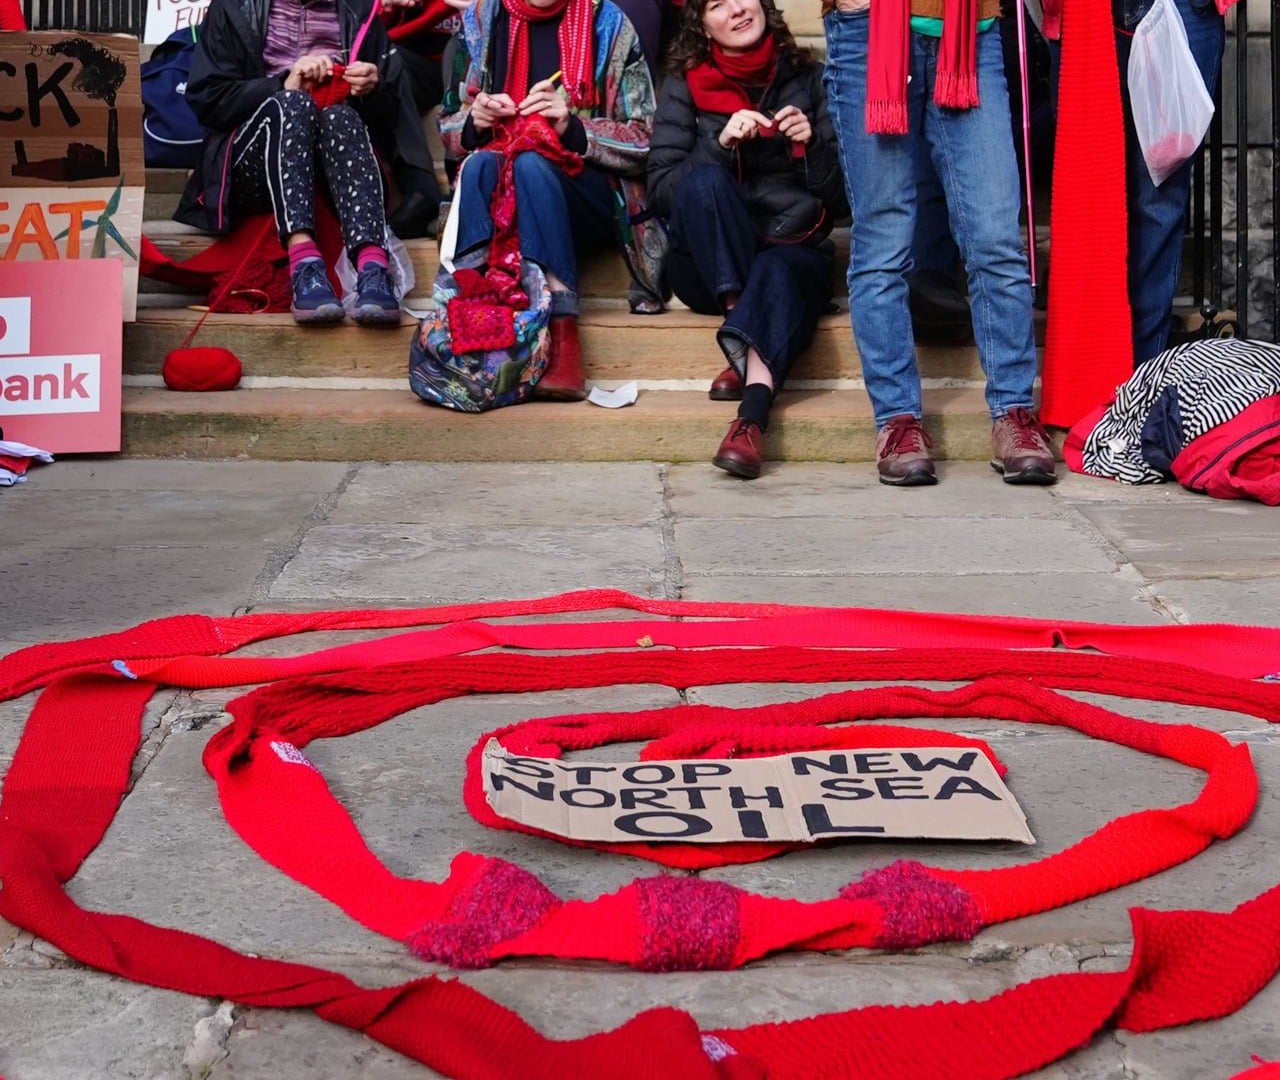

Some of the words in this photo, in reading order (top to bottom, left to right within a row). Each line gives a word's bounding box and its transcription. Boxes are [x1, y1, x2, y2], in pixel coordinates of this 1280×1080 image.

[502, 756, 733, 786] STOP
[791, 752, 979, 776] NEW
[490, 773, 785, 810] NORTH
[820, 776, 1003, 801] SEA
[613, 803, 886, 840] OIL
